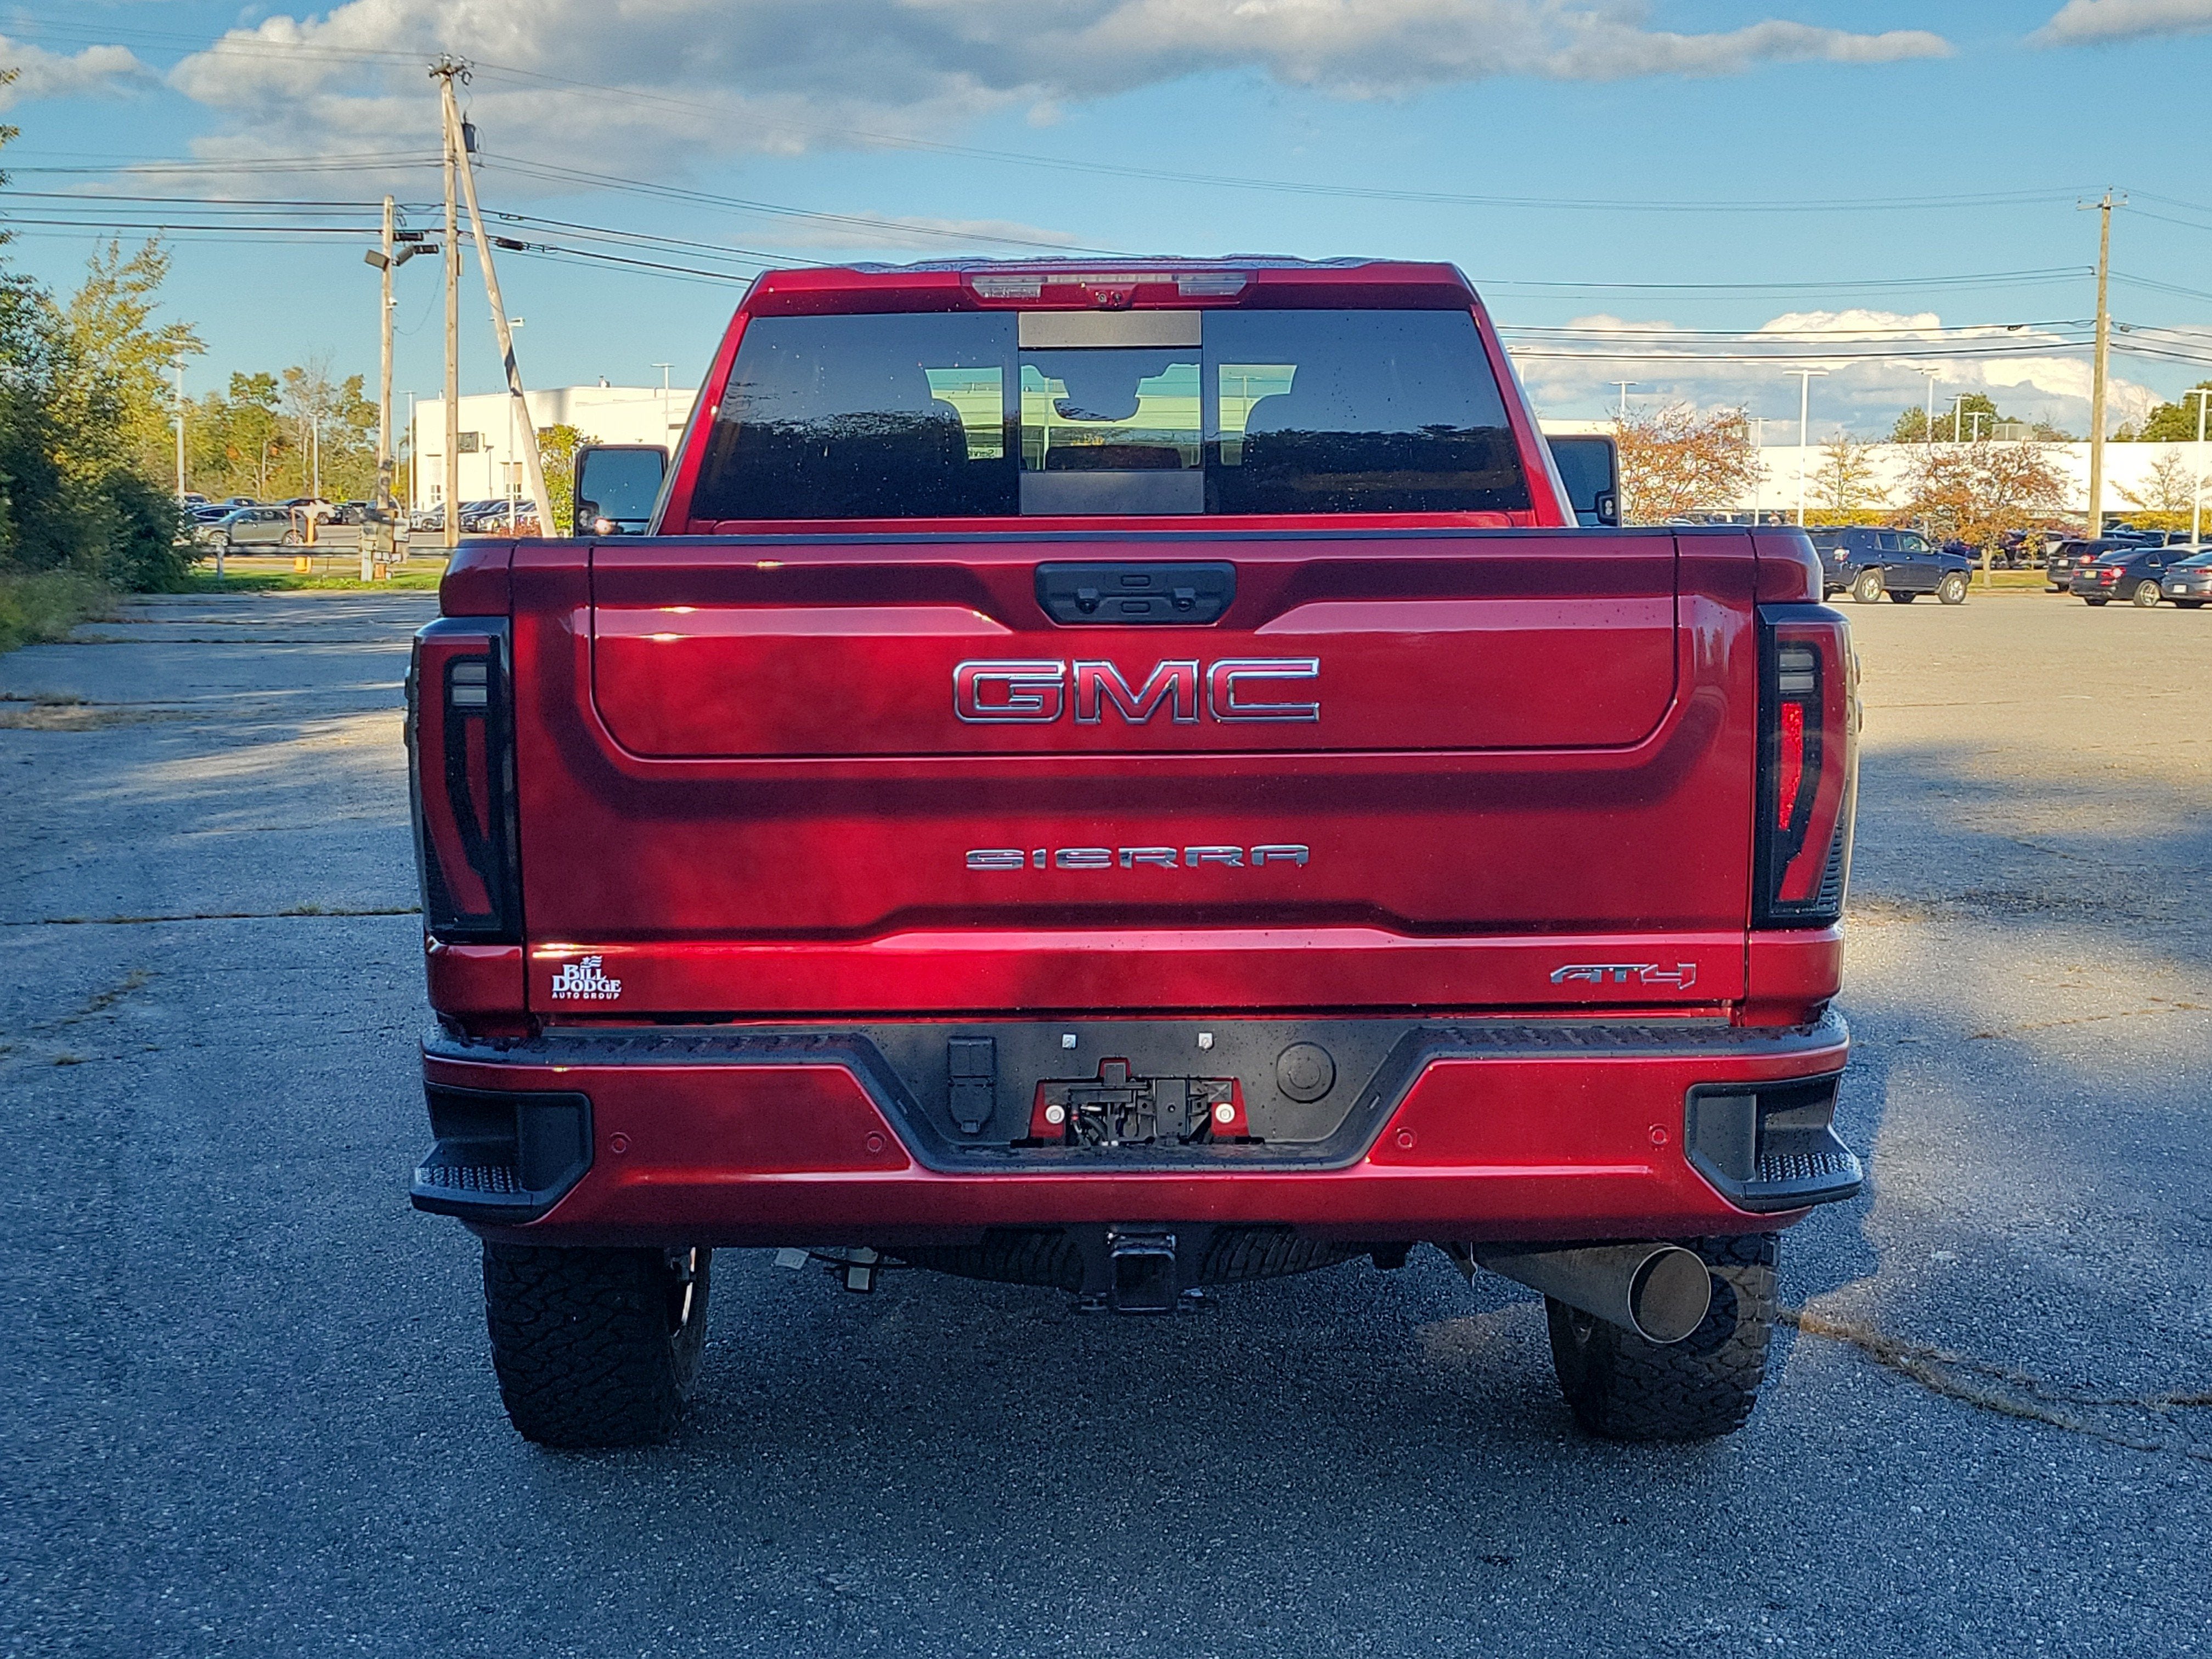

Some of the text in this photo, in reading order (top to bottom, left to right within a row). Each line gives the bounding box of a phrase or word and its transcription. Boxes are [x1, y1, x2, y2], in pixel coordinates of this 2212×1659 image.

[953, 658, 1321, 724] GMC
[966, 845, 1310, 870] SIERRA
[552, 975, 622, 992] DODGE
[563, 964, 607, 980] BILL
[1550, 963, 1697, 990] AT4
